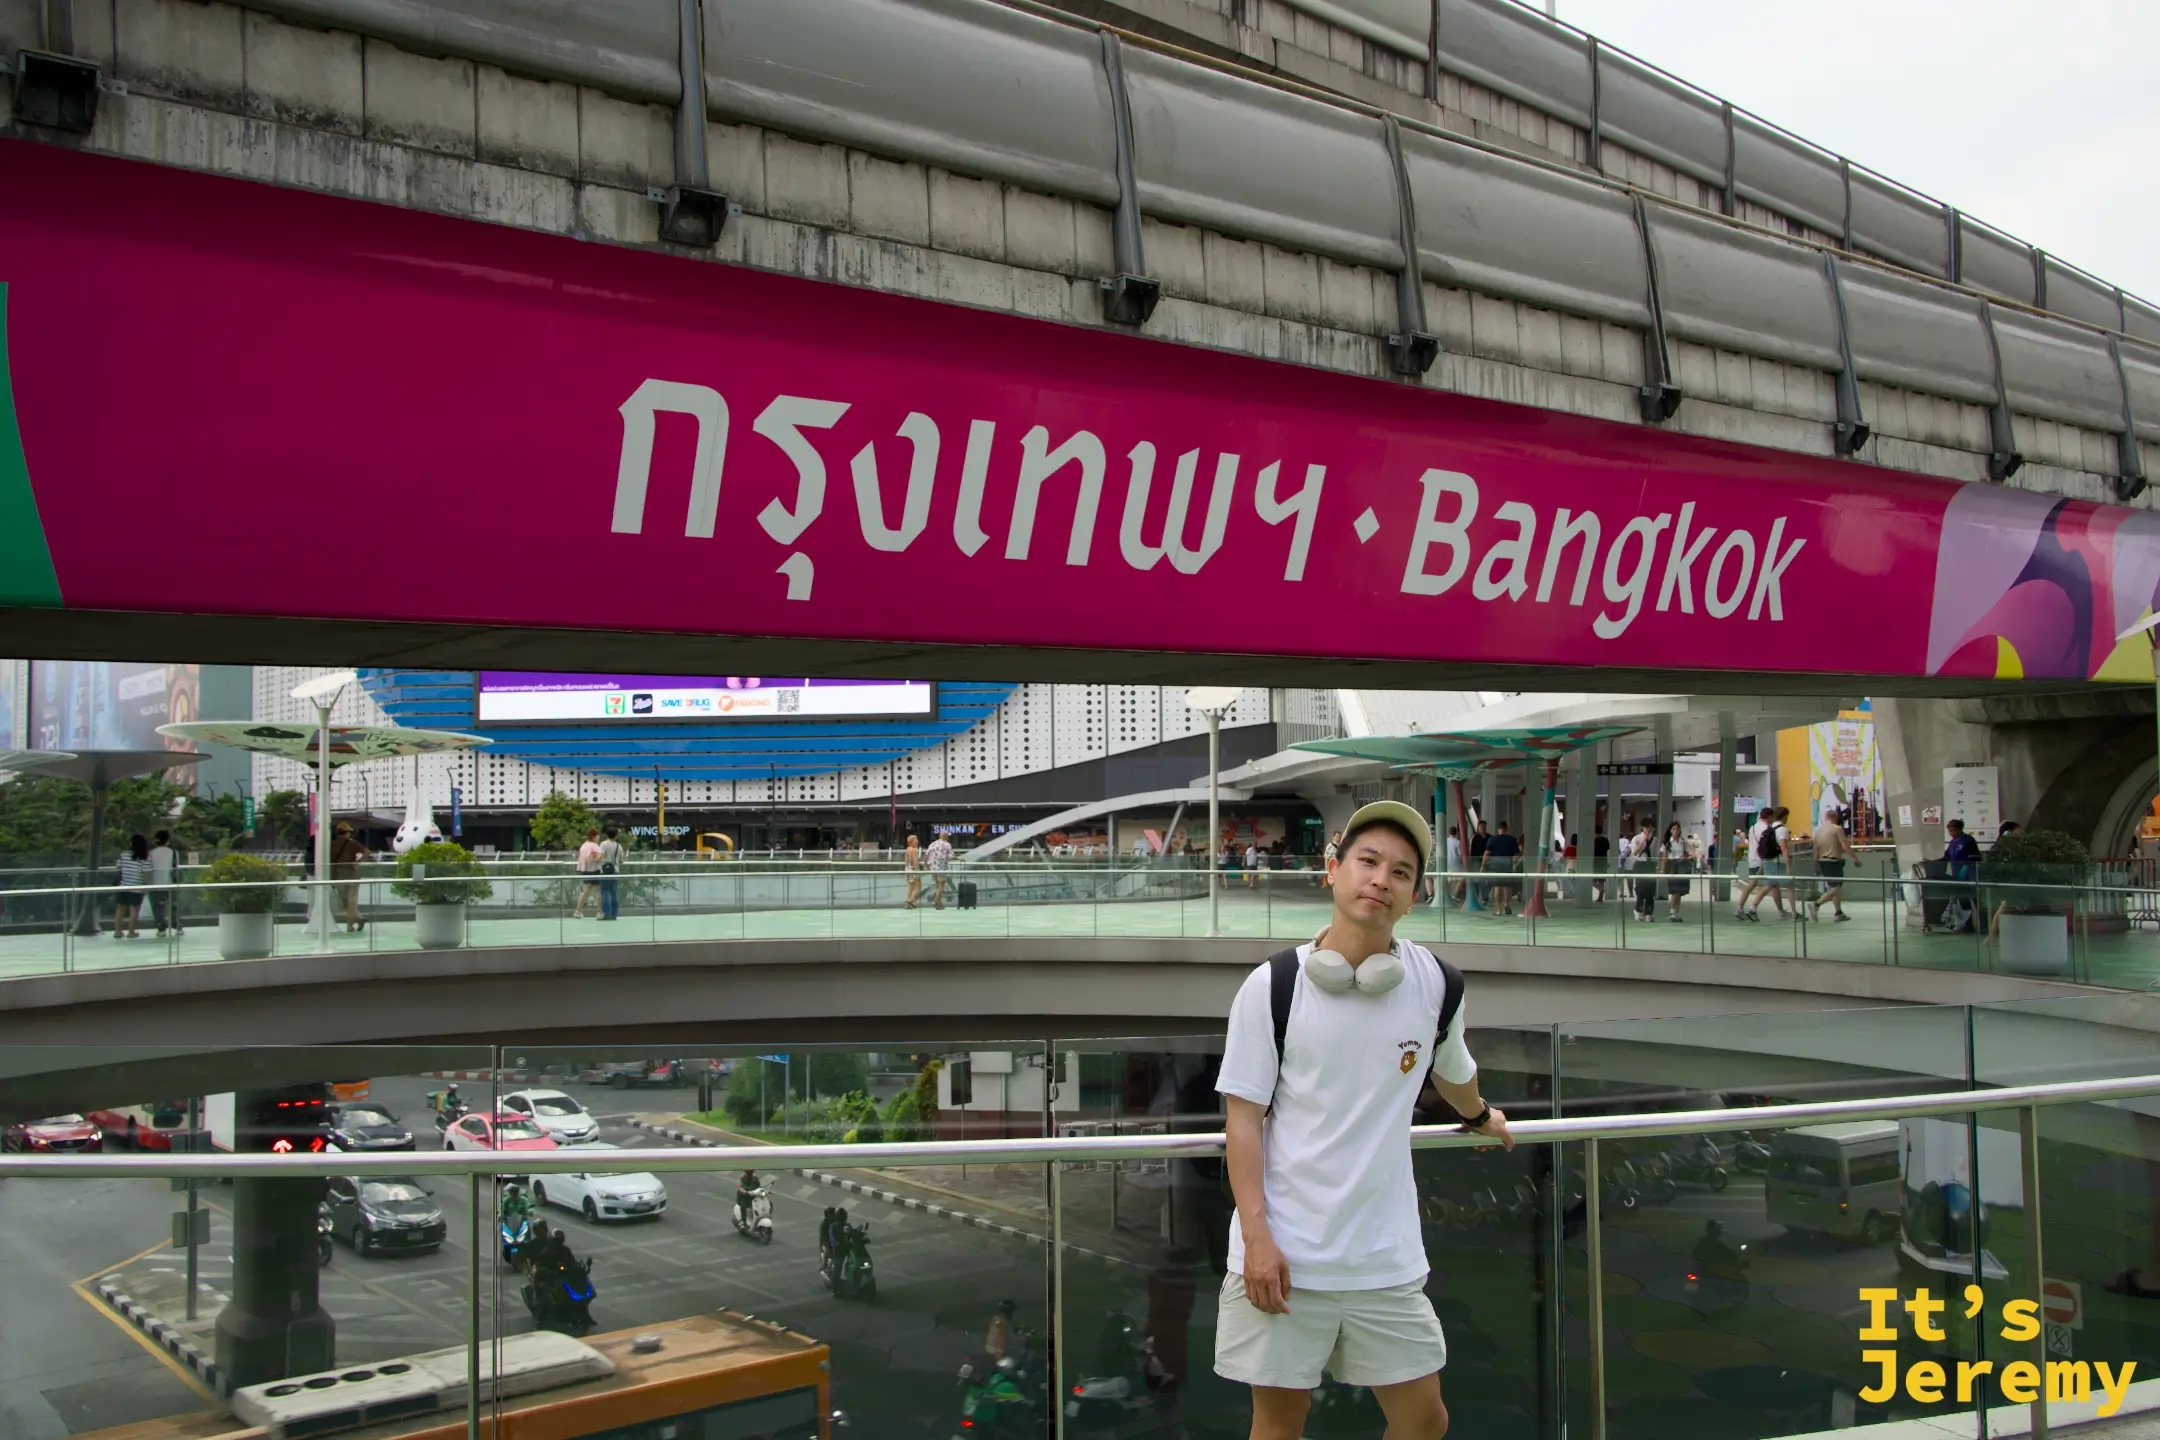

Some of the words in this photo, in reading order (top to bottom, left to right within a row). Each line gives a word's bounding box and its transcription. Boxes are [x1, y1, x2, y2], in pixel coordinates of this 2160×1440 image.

[610, 378, 1327, 601] กรุงเทพฯ
[1400, 467, 1807, 640] Bangkok
[661, 699, 683, 707] SAVE
[686, 698, 710, 707] DRUG
